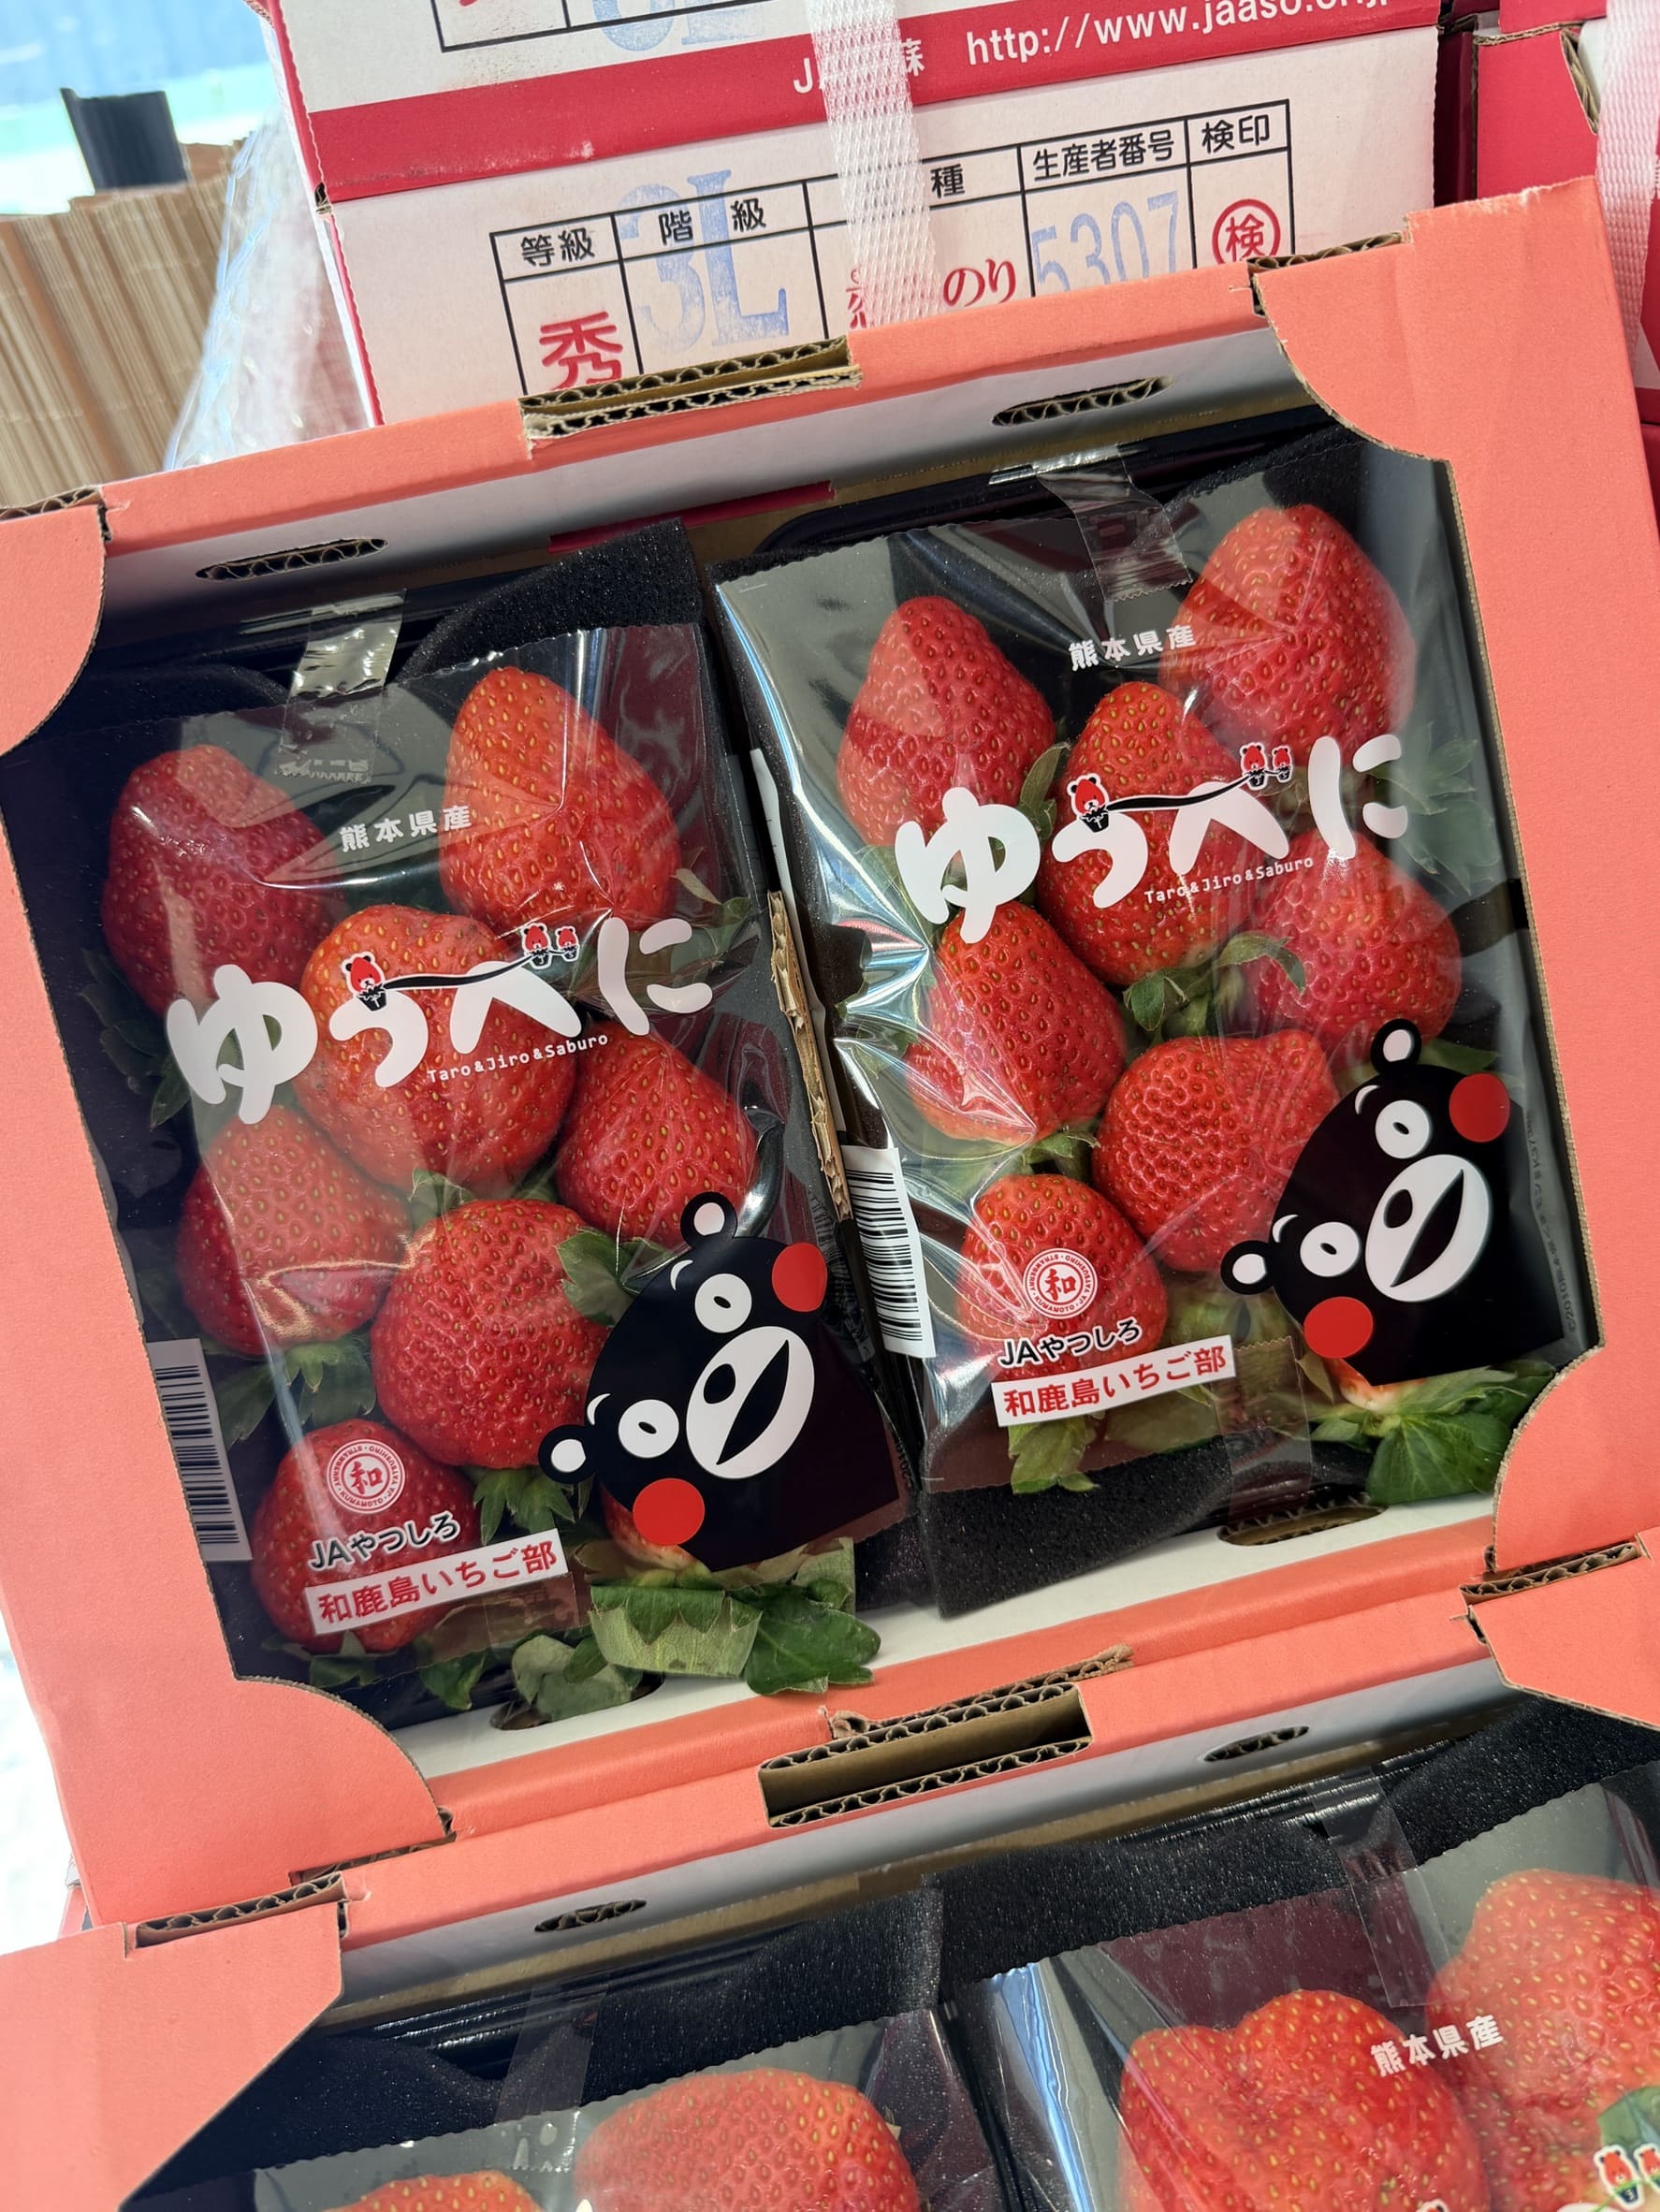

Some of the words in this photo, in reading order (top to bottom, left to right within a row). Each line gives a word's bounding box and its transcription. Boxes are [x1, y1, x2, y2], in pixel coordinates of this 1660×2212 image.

[967, 0, 1388, 65] http://www.jaaso..
[1033, 130, 1174, 182] 生産者番号
[1201, 114, 1271, 154] 検印
[521, 227, 595, 267] 等級
[659, 197, 766, 246] 階級
[611, 169, 789, 354] 3L
[539, 311, 624, 390] 秀
[1069, 624, 1197, 672] 熊本県産
[339, 805, 473, 852] 熊本県産
[1044, 1268, 1076, 1302] 和
[998, 1317, 1143, 1368] JAやつしろ
[1003, 1345, 1228, 1418] 和鹿島いちご部
[349, 1461, 384, 1495] 和
[308, 1511, 460, 1571] JAやつしろ
[317, 1539, 558, 1624] 和鹿島いちご部
[1370, 2014, 1505, 2077] 熊本県産
